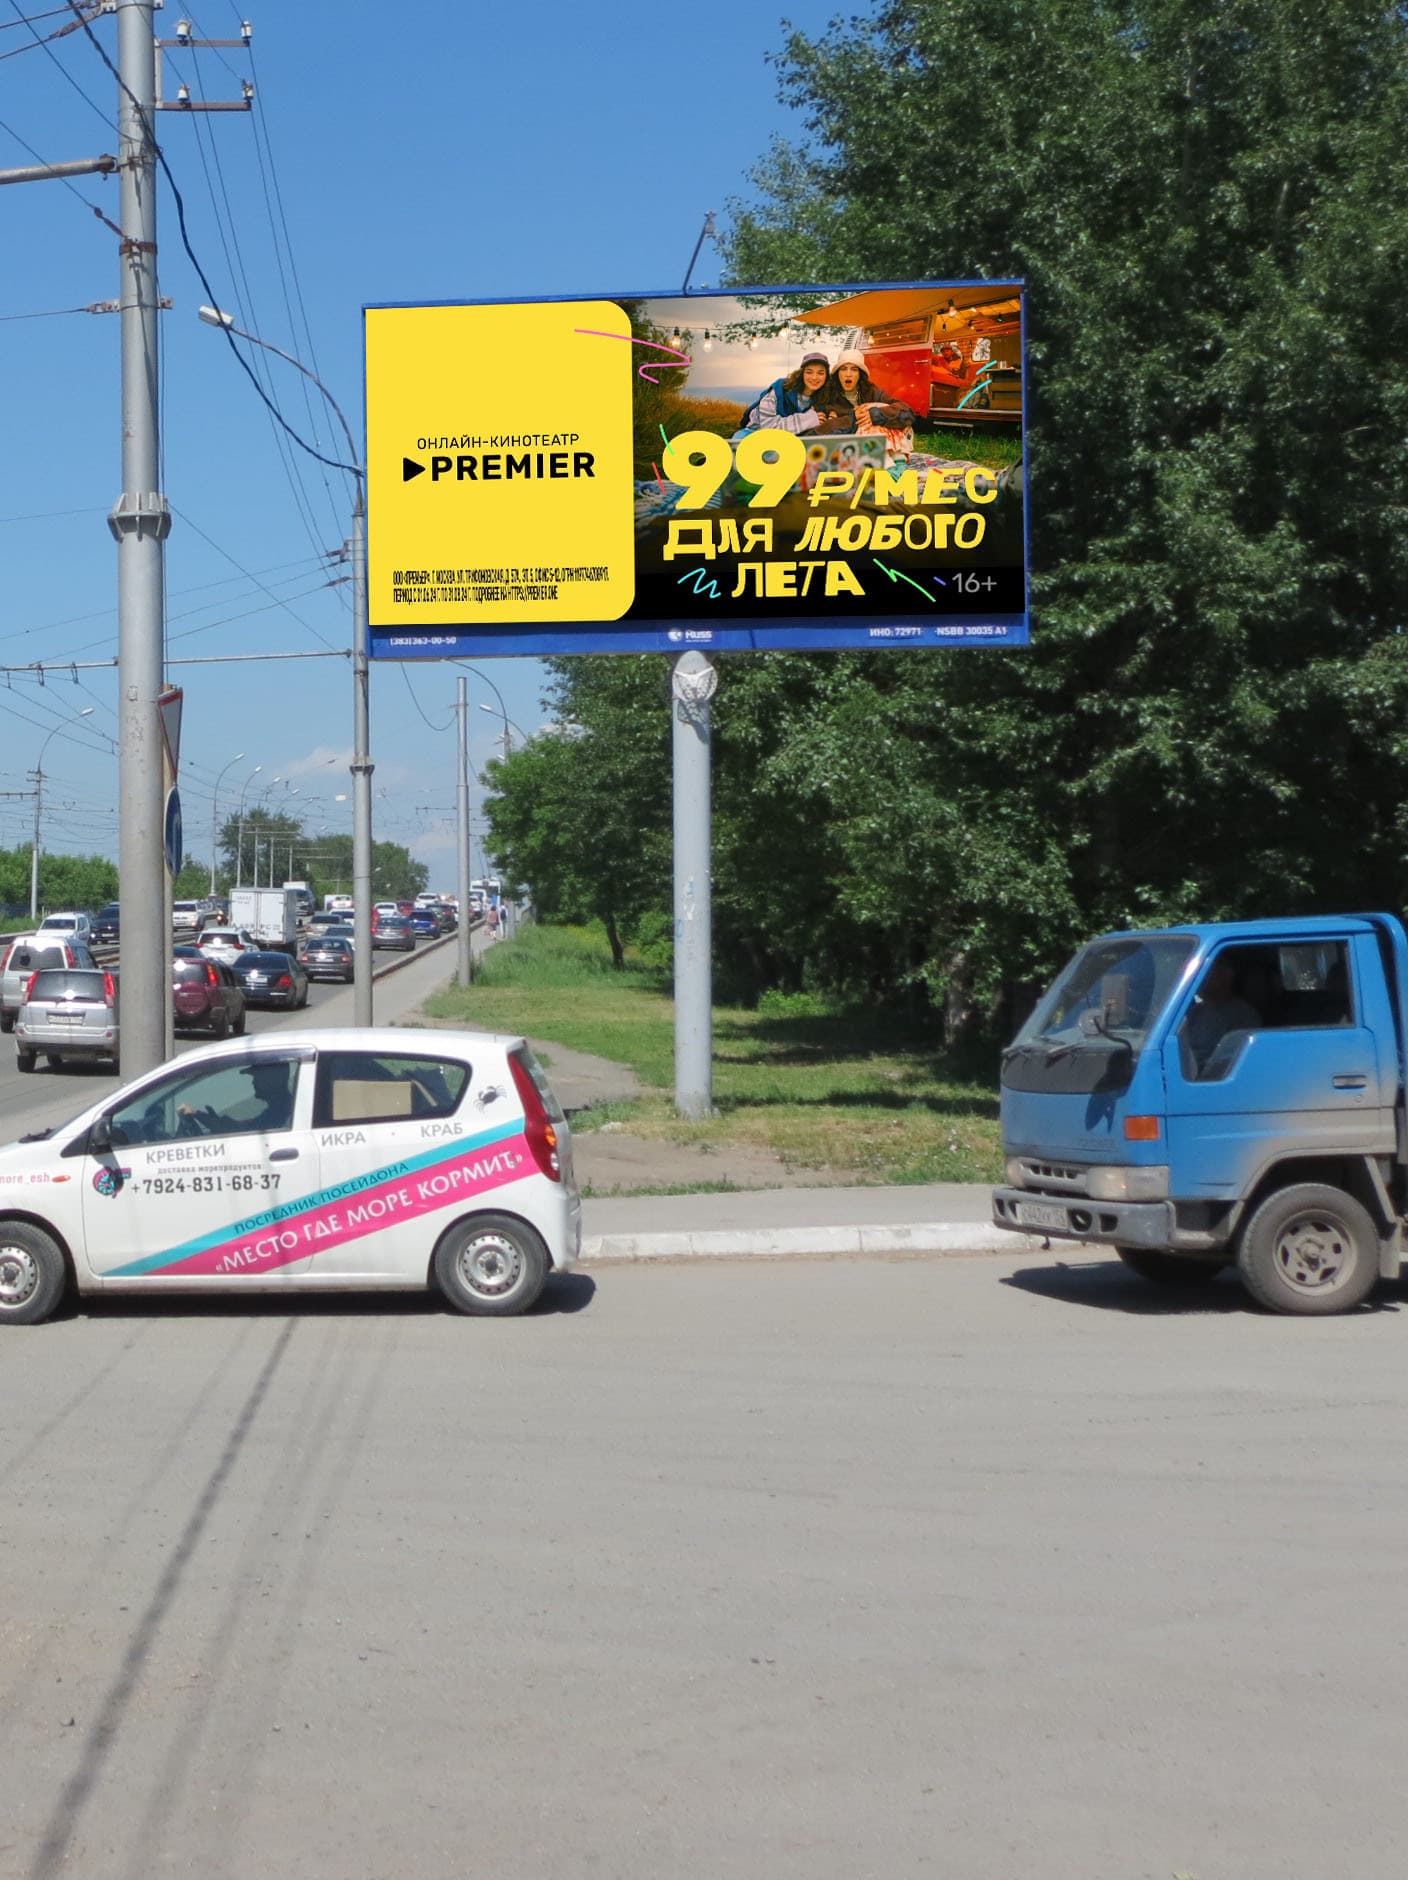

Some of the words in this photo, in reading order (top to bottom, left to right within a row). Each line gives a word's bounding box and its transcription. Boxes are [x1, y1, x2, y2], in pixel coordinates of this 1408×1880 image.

[417, 433, 580, 449] ОНЛАЙН-КИНОТЕАТР
[431, 452, 596, 482] PREMIER
[662, 428, 807, 510] 99
[662, 518, 774, 561] ДЛЯ
[793, 512, 987, 552] ЛЮБОГО
[731, 560, 866, 598] ЛЕТА
[951, 572, 998, 594] 16+
[320, 1130, 367, 1147] ИКРА
[420, 1122, 464, 1138] КРАБ
[146, 1143, 226, 1165] КРЕВЕТКИ
[157, 1166, 196, 1175] доставка
[198, 1163, 262, 1173] морепродуктов
[131, 1173, 282, 1195] +7924-831-68-37
[233, 1195, 318, 1235] ПОСРЕДНИК
[319, 1161, 410, 1204] ПОСЕЙДОНА
[215, 1230, 299, 1273] «МЕСТО
[303, 1213, 343, 1242] ГДЕ
[346, 1187, 414, 1228] МОРЕ
